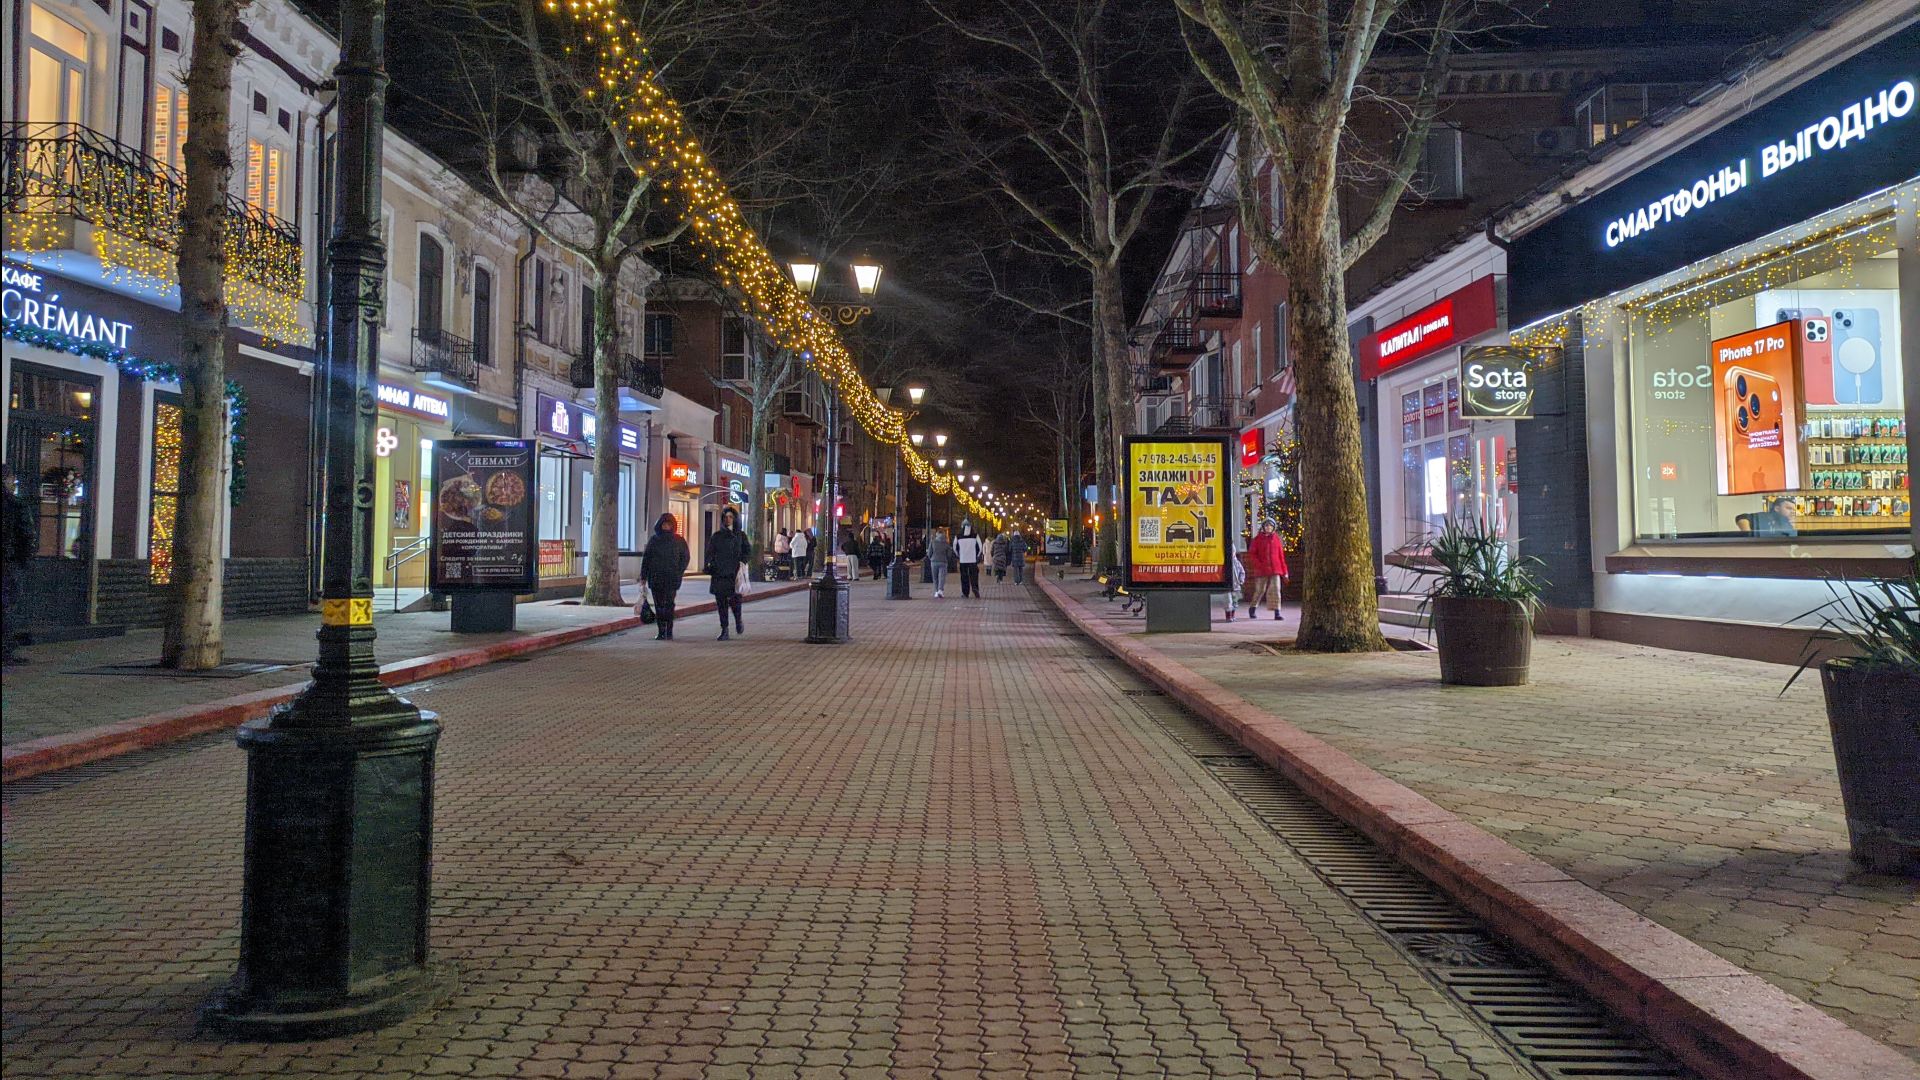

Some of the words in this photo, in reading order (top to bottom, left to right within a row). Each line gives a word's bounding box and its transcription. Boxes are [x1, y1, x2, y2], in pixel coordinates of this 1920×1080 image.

[1605, 158, 1748, 248] СМАРТФОНЫ
[1761, 80, 1915, 178] ВЫГОДНО
[2, 266, 42, 292] КАФЕ
[2, 289, 133, 349] CRÉMANT
[1380, 325, 1420, 357] КАПИТАЛ
[1720, 344, 1752, 363] iPhone
[1754, 338, 1765, 354] 17
[1767, 336, 1785, 351] Pro
[1468, 364, 1527, 389] Sota
[413, 394, 448, 416] АПТЕКА
[1495, 389, 1527, 400] store
[468, 457, 519, 466] CREMANT
[1137, 454, 1147, 464] +7
[1150, 453, 1216, 464] 978-2-45-45-45
[1139, 470, 1187, 482] ЗАКАЖИ
[1189, 471, 1215, 484] UP
[1139, 487, 1213, 504] TAXI
[1139, 565, 1180, 573] ПРИГЛАШАЕМ
[1182, 565, 1218, 573] ВОДИТЕЛЕЙ
